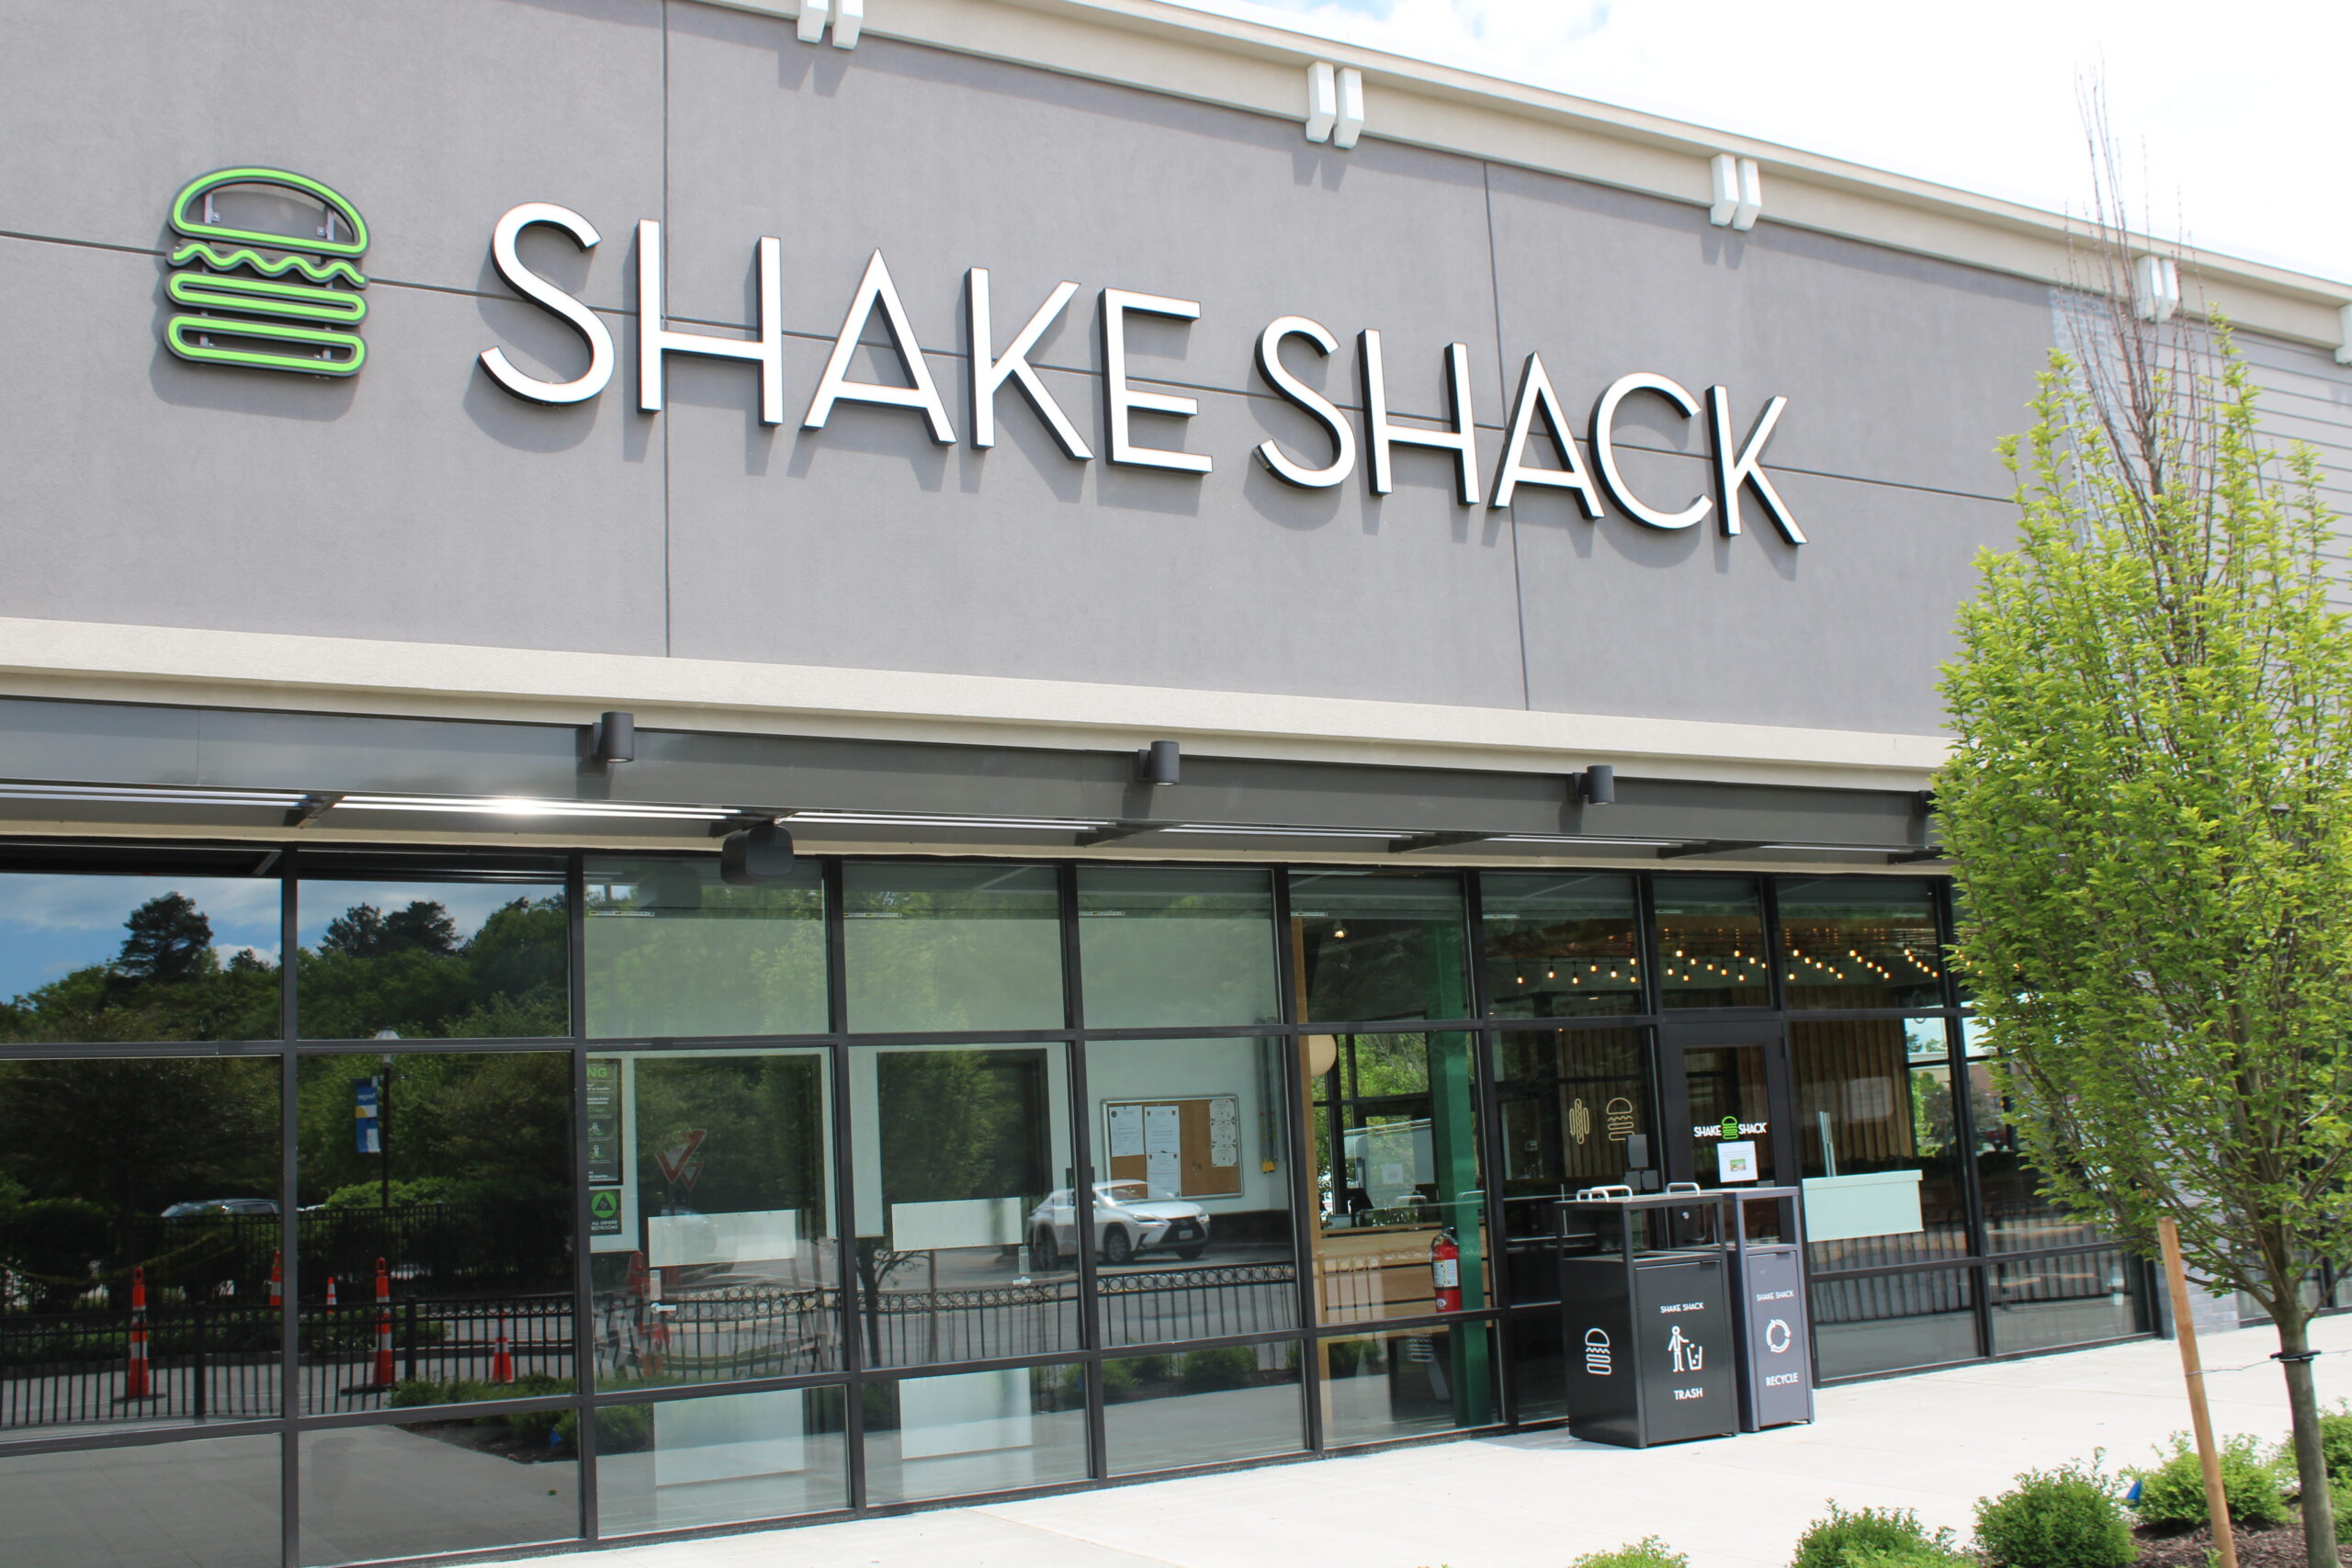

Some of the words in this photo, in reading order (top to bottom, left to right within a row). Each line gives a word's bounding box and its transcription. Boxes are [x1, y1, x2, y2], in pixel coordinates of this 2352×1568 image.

[479, 202, 1213, 473] SHAKE
[1252, 315, 1808, 544] SHACK
[1693, 1125, 1722, 1137] SHAKE
[1738, 1122, 1768, 1134] SHACK
[1776, 1291, 1793, 1299] SHACK
[1660, 1304, 1681, 1314] SHAKE
[1682, 1302, 1704, 1311] SHACK
[1766, 1372, 1798, 1387] RECYCLE
[1674, 1387, 1703, 1401] TRASH
